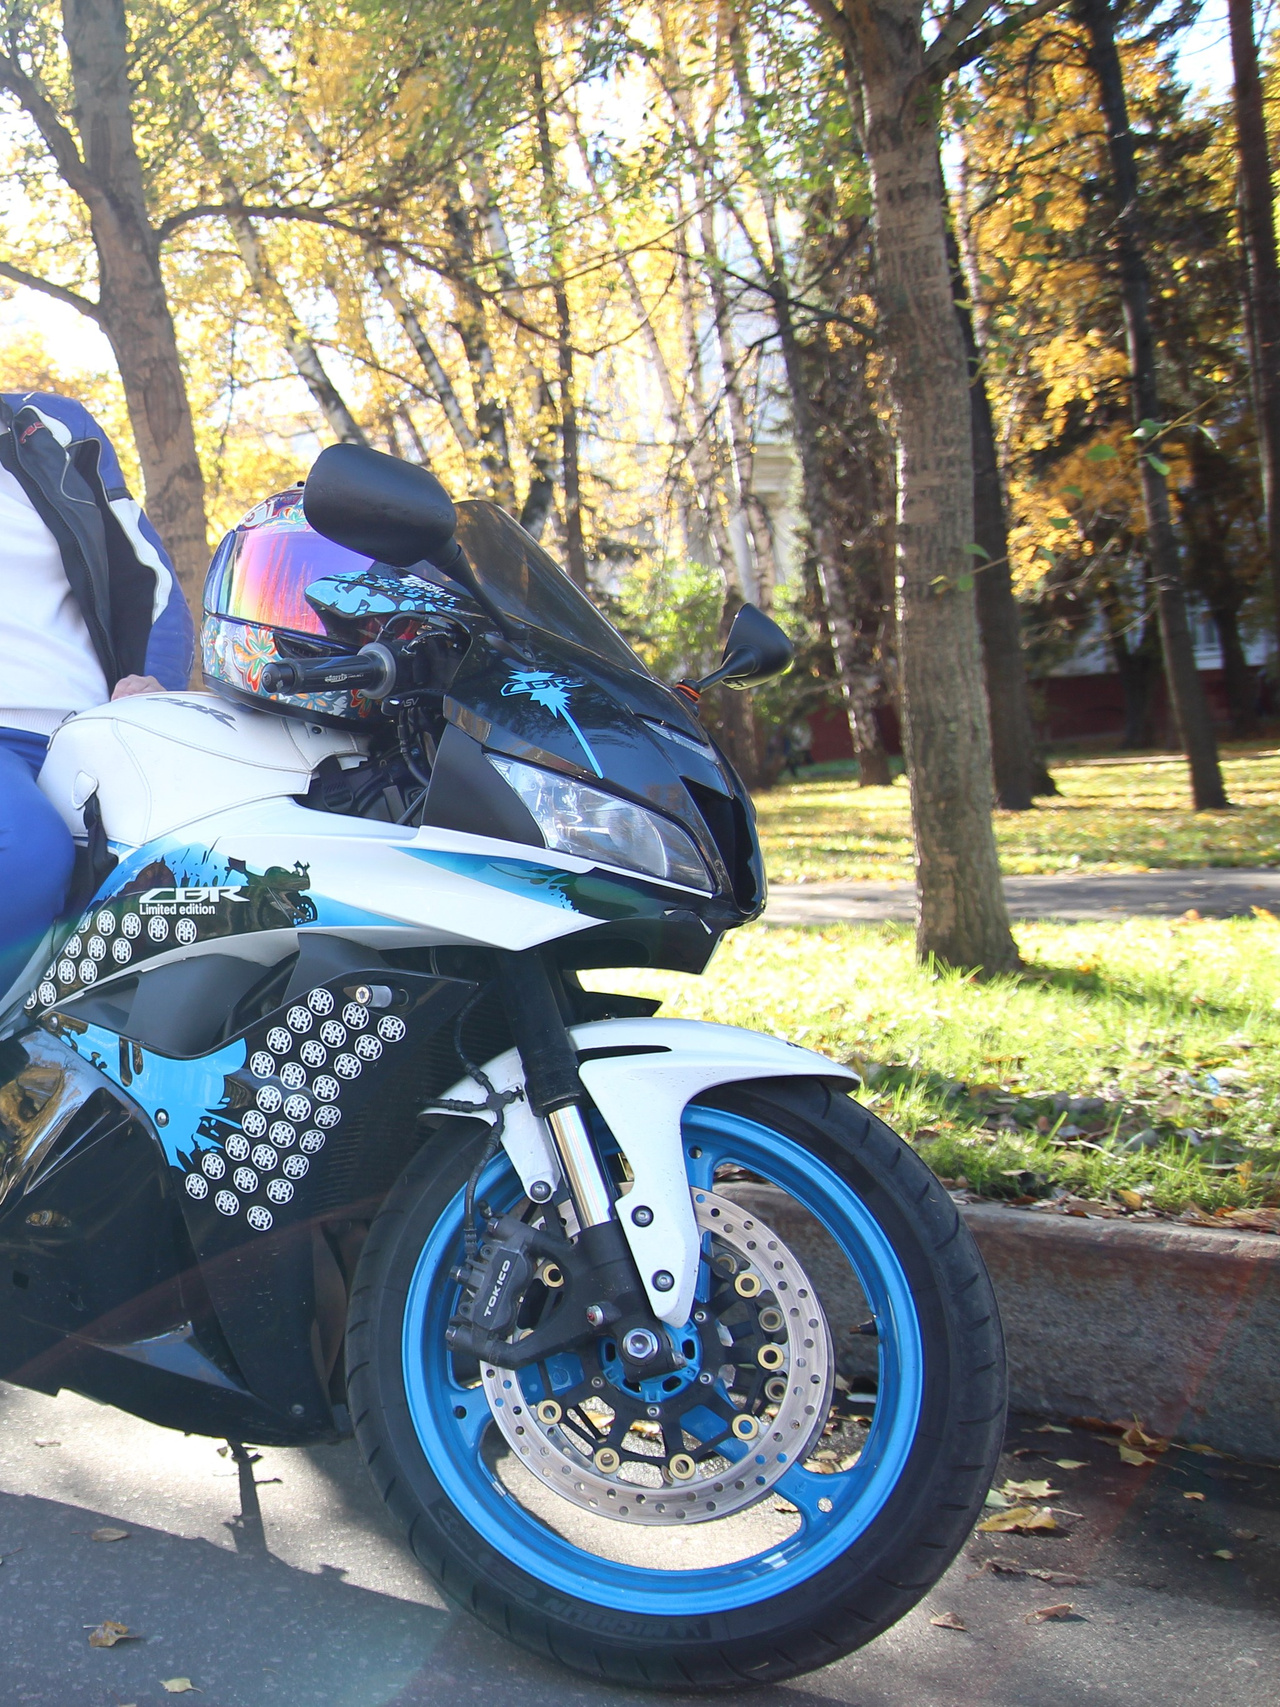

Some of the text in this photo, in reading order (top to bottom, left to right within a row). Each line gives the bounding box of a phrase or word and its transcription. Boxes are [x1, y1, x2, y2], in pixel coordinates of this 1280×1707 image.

[500, 676, 586, 697] CBR
[139, 886, 250, 904] CBR
[139, 904, 216, 916] Limited edition
[100, 912, 112, 923] 600
[125, 915, 138, 926] 600
[151, 917, 165, 928] 600
[178, 920, 194, 932] 600
[90, 938, 103, 948] 600
[115, 940, 129, 951] 600
[61, 960, 73, 972] 600
[82, 960, 94, 972] 600
[42, 983, 54, 994] 600
[313, 990, 331, 1002] 600
[311, 998, 330, 1013] RR
[347, 1004, 366, 1016] 600
[292, 1008, 309, 1020] 600
[345, 1011, 365, 1026] RR
[290, 1015, 308, 1030] RR
[325, 1022, 343, 1034] 600
[383, 1018, 402, 1029] 600
[272, 1029, 289, 1041] 600
[323, 1030, 342, 1045] RR
[380, 1025, 401, 1039] RR
[270, 1036, 288, 1051] RR
[305, 1042, 323, 1054] 600
[360, 1037, 379, 1048] 600
[303, 1049, 322, 1064] RR
[358, 1044, 378, 1058] RR
[255, 1053, 272, 1065] 600
[339, 1055, 358, 1066] 600
[253, 1061, 271, 1076] RR
[285, 1064, 303, 1076] 600
[337, 1062, 357, 1076] RR
[283, 1072, 302, 1087] RR
[317, 1077, 336, 1089] 600
[261, 1087, 279, 1099] 600
[315, 1084, 335, 1099] RR
[259, 1095, 278, 1110] RR
[289, 1096, 308, 1108] 600
[287, 1104, 307, 1119] RR
[319, 1107, 338, 1117] 600
[247, 1112, 263, 1124] 600
[317, 1113, 337, 1126] RR
[245, 1119, 262, 1134] RR
[274, 1123, 293, 1135] 600
[230, 1136, 247, 1148] 600
[272, 1130, 292, 1145] RR
[305, 1132, 322, 1142] 600
[228, 1143, 246, 1158] RR
[303, 1138, 321, 1151] RR
[257, 1146, 274, 1157] 600
[207, 1155, 222, 1166] 600
[255, 1153, 273, 1167] RR
[288, 1157, 306, 1167] 600
[205, 1162, 221, 1176] RR
[238, 1169, 255, 1180] 600
[286, 1163, 305, 1176] RR
[190, 1176, 206, 1187] 600
[236, 1176, 254, 1190] RR
[272, 1181, 291, 1192] 600
[188, 1182, 204, 1196] RR
[270, 1188, 290, 1201] RR
[220, 1192, 236, 1203] 600
[218, 1198, 235, 1212] RR
[252, 1208, 269, 1218] 600
[250, 1214, 268, 1227] RR
[483, 1260, 511, 1317] TOKICO
[545, 1599, 670, 1638] MICHELIN
